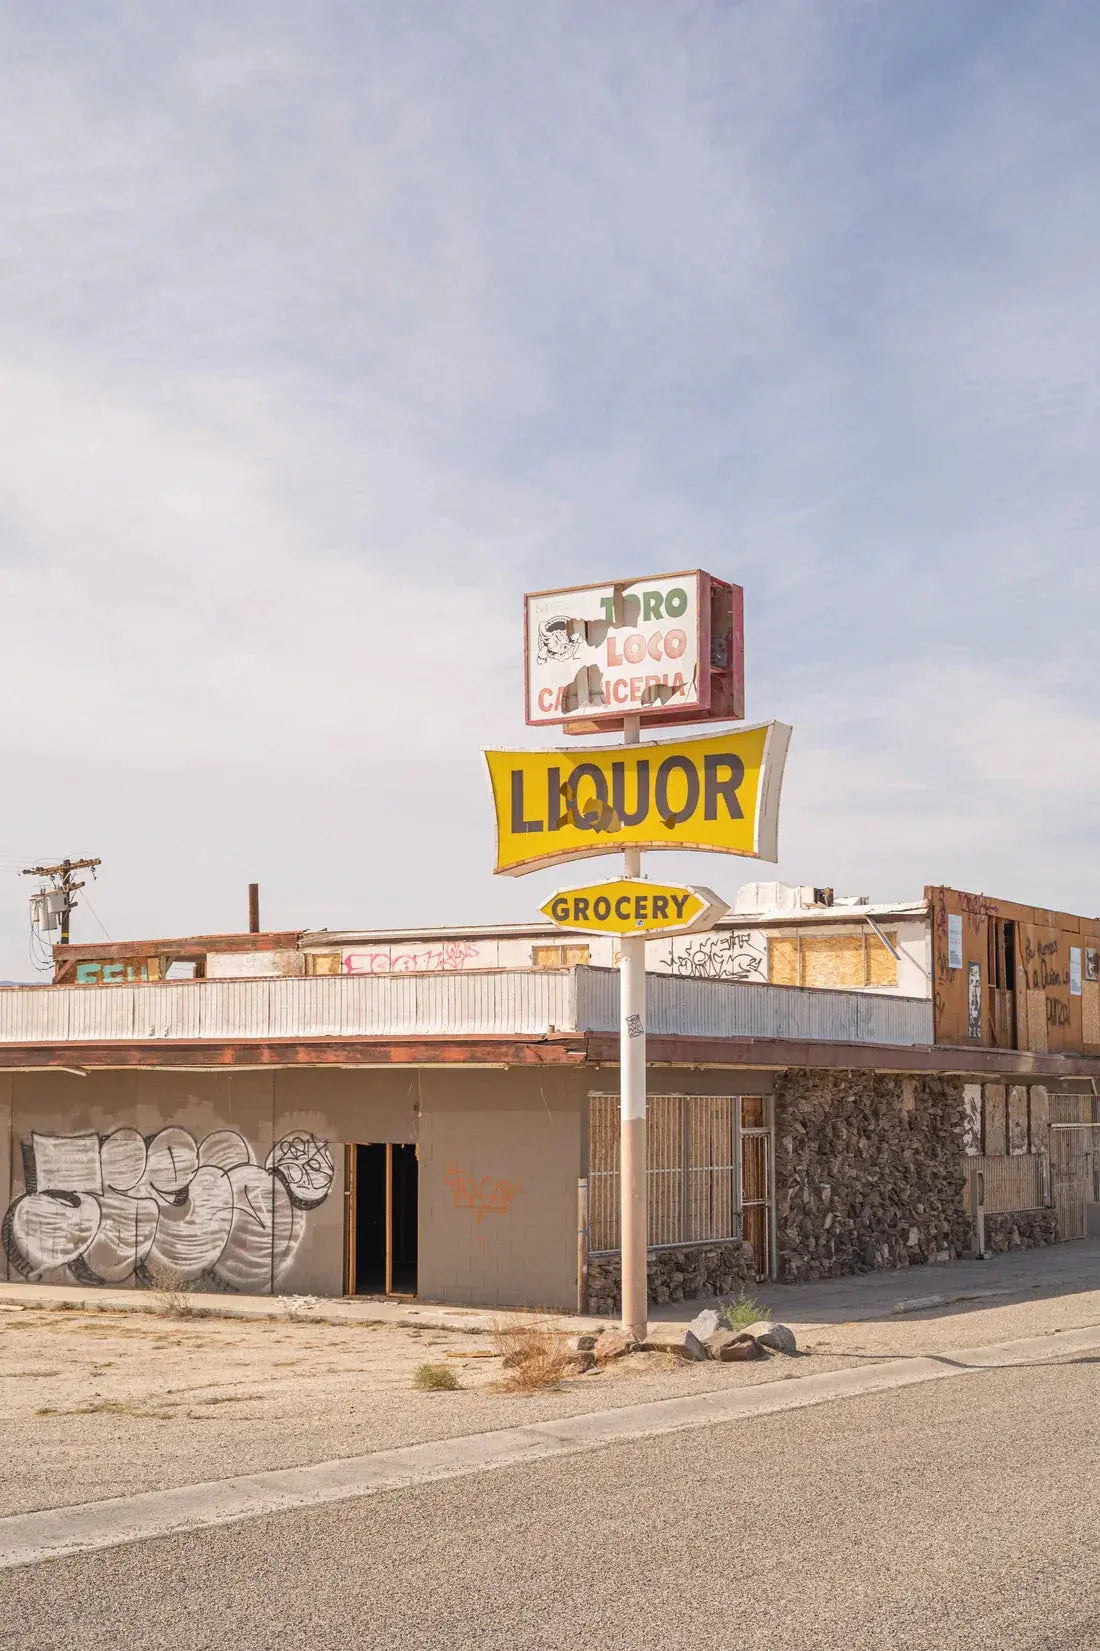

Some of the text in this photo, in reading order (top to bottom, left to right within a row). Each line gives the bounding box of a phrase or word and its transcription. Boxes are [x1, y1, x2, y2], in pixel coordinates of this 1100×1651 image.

[600, 588, 688, 623] TRO
[607, 628, 687, 667] LOCO
[511, 753, 745, 834] LIQUOR
[551, 895, 690, 921] GROCERY
